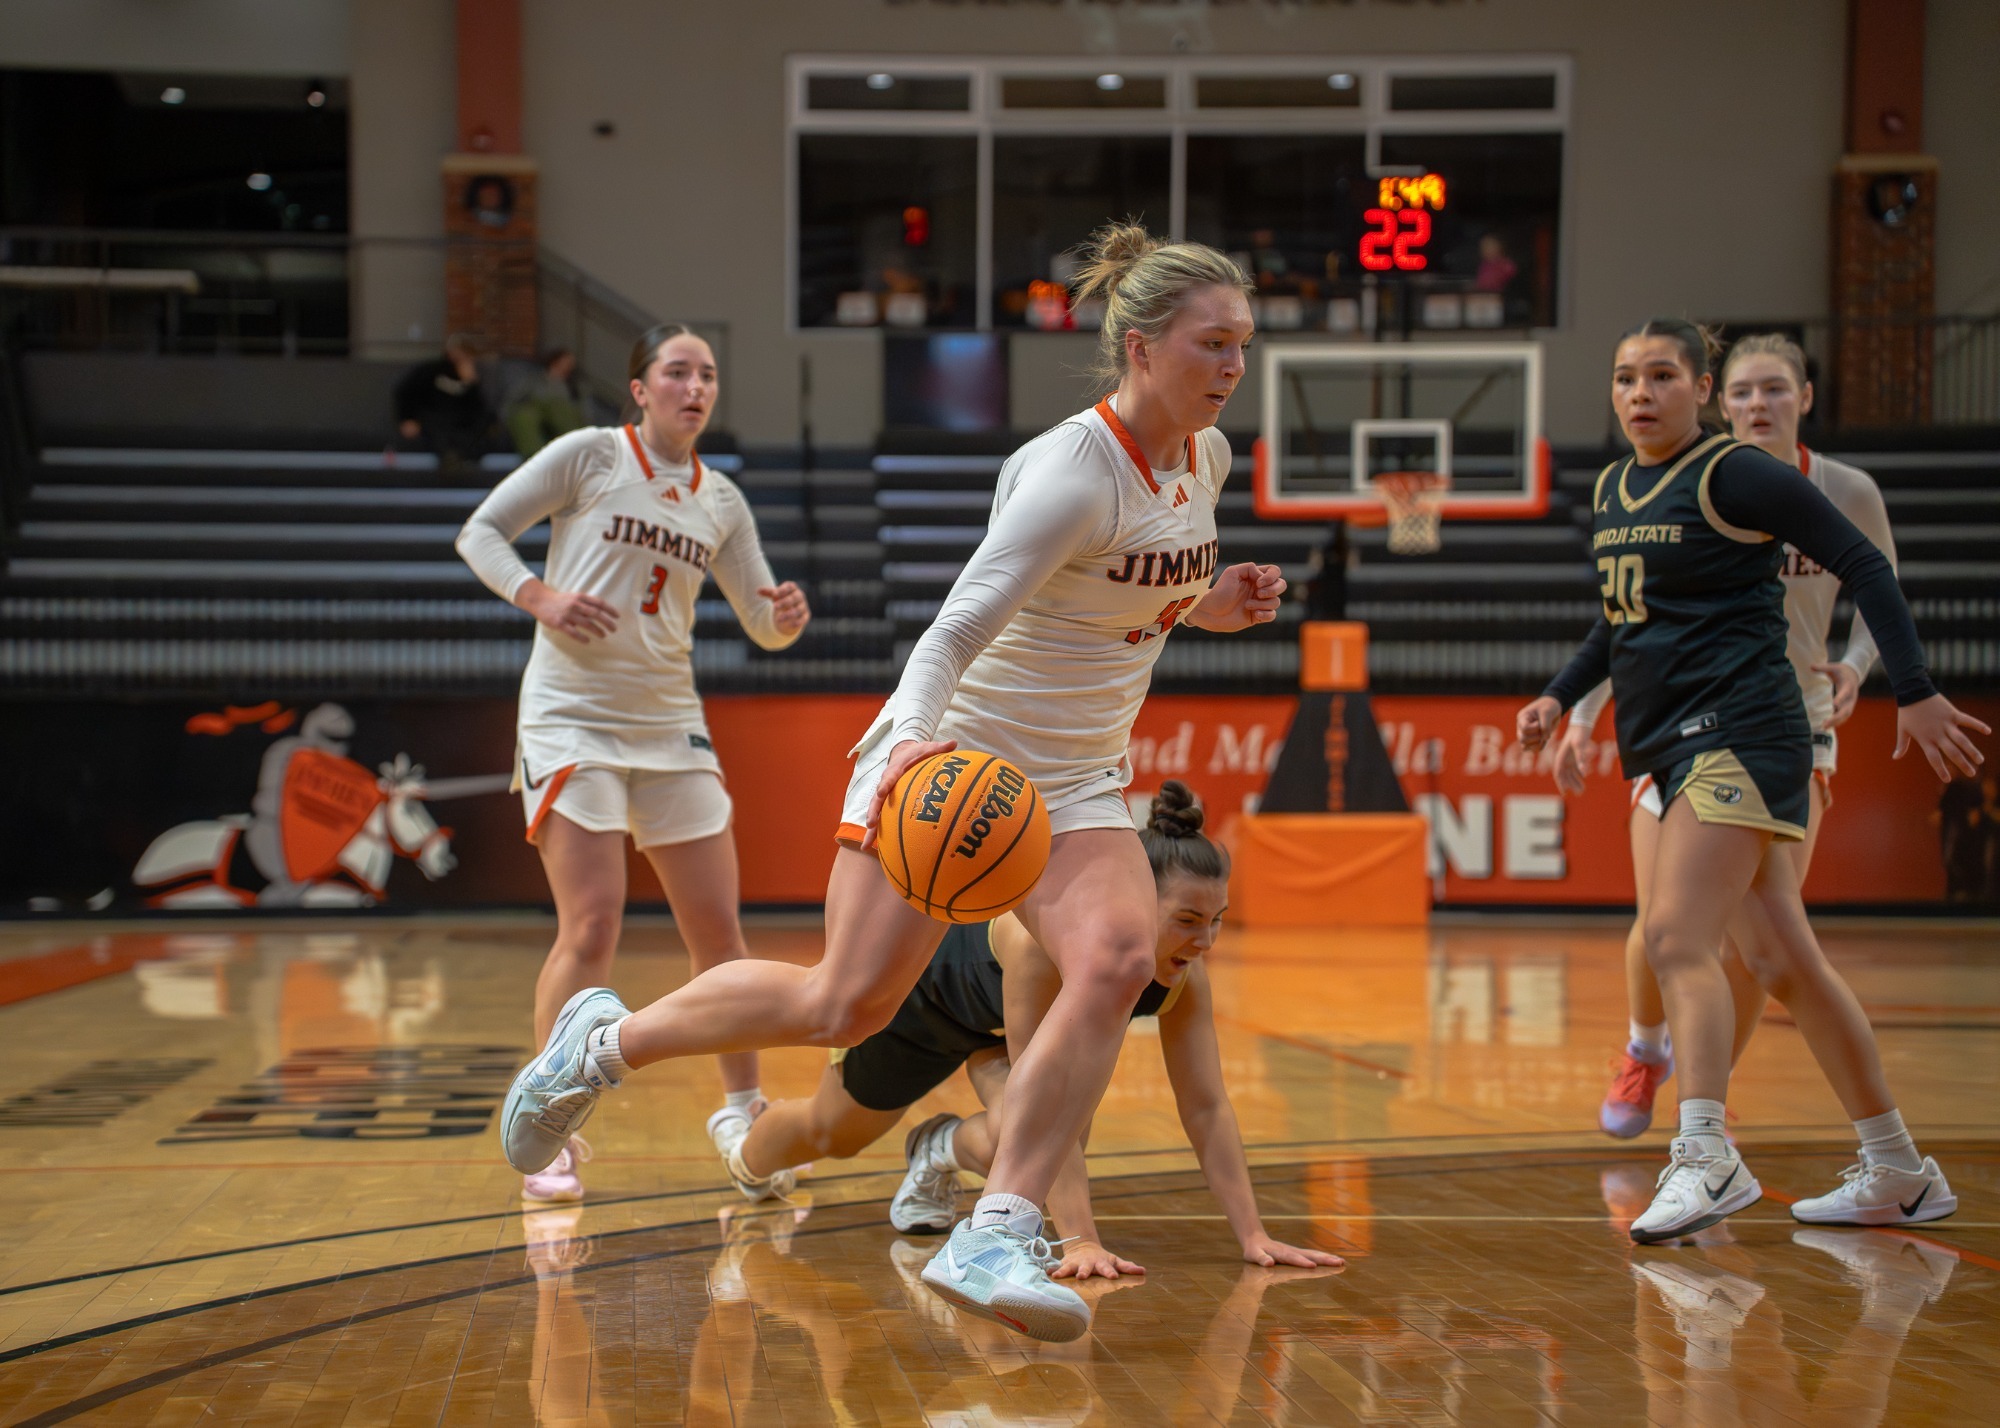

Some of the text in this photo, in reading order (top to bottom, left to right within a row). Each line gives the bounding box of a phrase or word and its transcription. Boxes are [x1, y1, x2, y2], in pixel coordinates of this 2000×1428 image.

[1359, 208, 1431, 270] 22
[1628, 524, 1683, 543] STATE
[640, 563, 668, 617] 3
[1597, 553, 1648, 626] 20
[915, 755, 972, 824] NCAA
[955, 765, 1026, 859] Wilson
